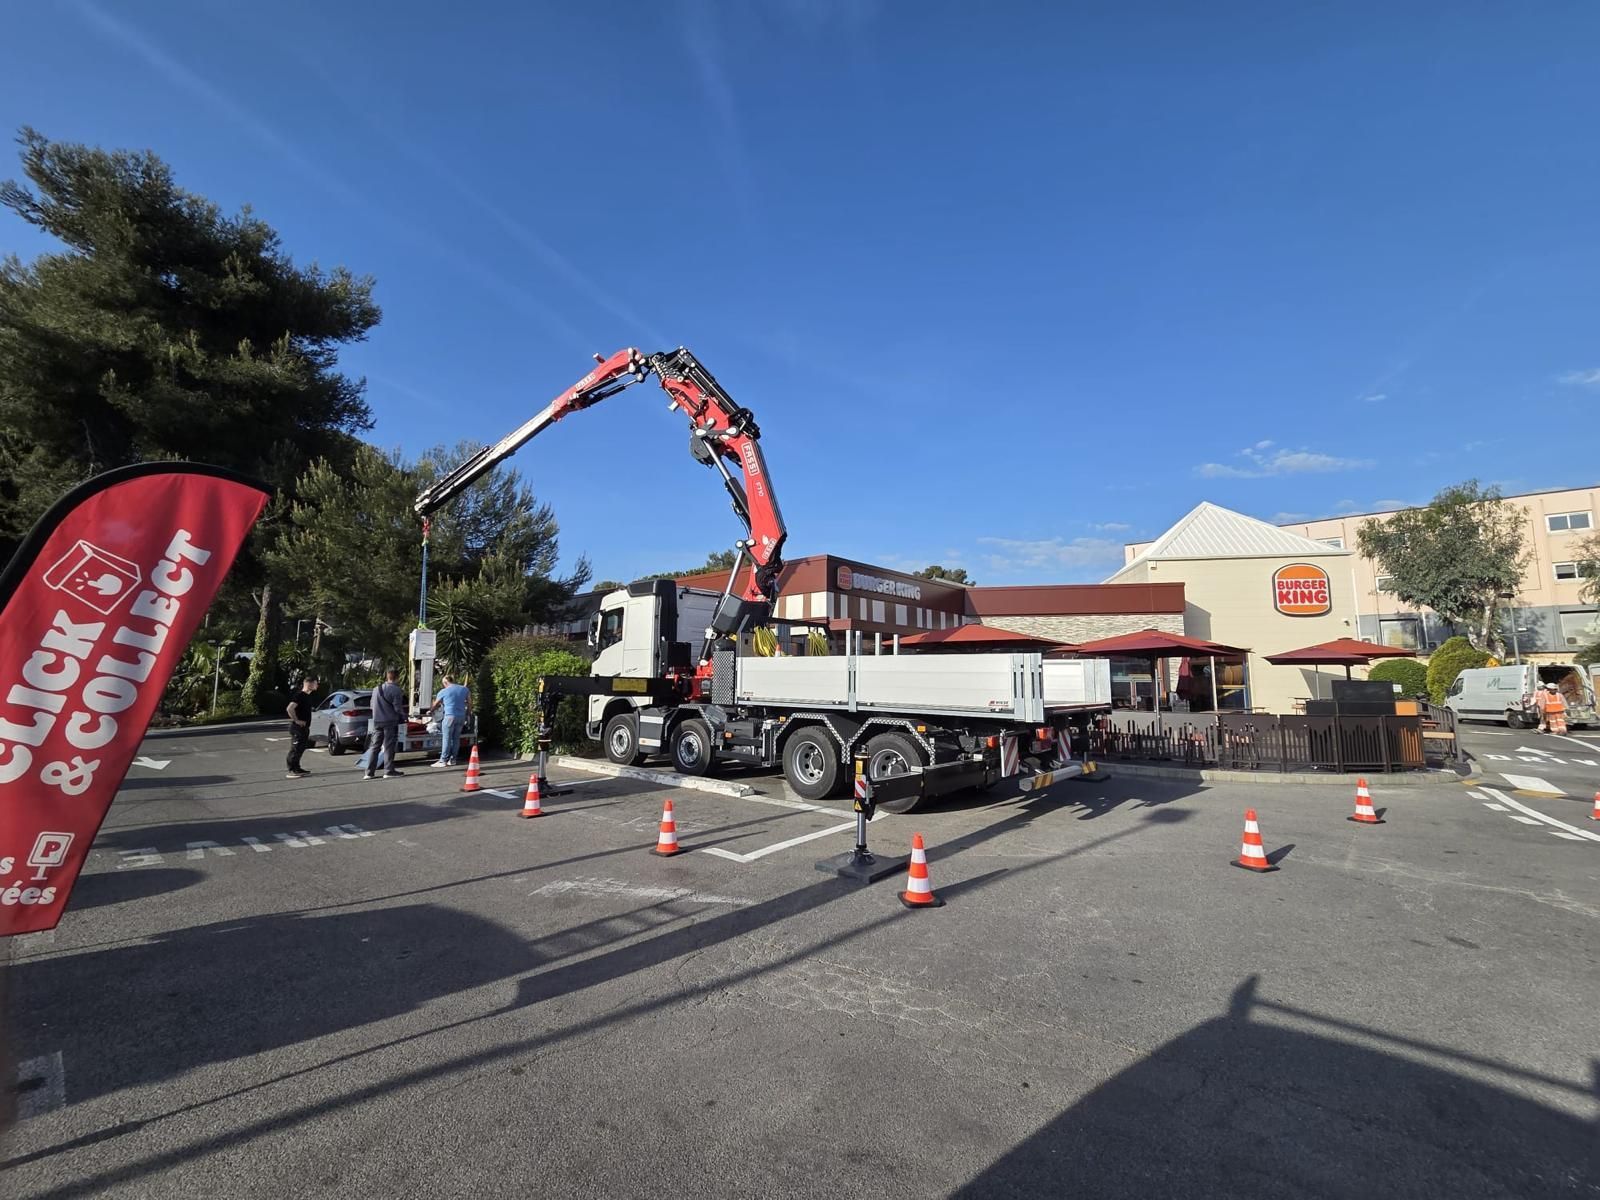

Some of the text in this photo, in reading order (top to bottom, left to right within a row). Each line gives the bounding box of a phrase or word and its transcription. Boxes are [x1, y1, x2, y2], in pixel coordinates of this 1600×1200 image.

[743, 445, 758, 475] FASSI
[852, 572, 896, 596] BURGER
[896, 581, 921, 601] KING
[1277, 580, 1327, 590] BURGER
[1278, 590, 1328, 604] KING
[40, 528, 212, 795] & COLLECT
[0, 609, 106, 783] CLICK
[40, 841, 61, 857] P
